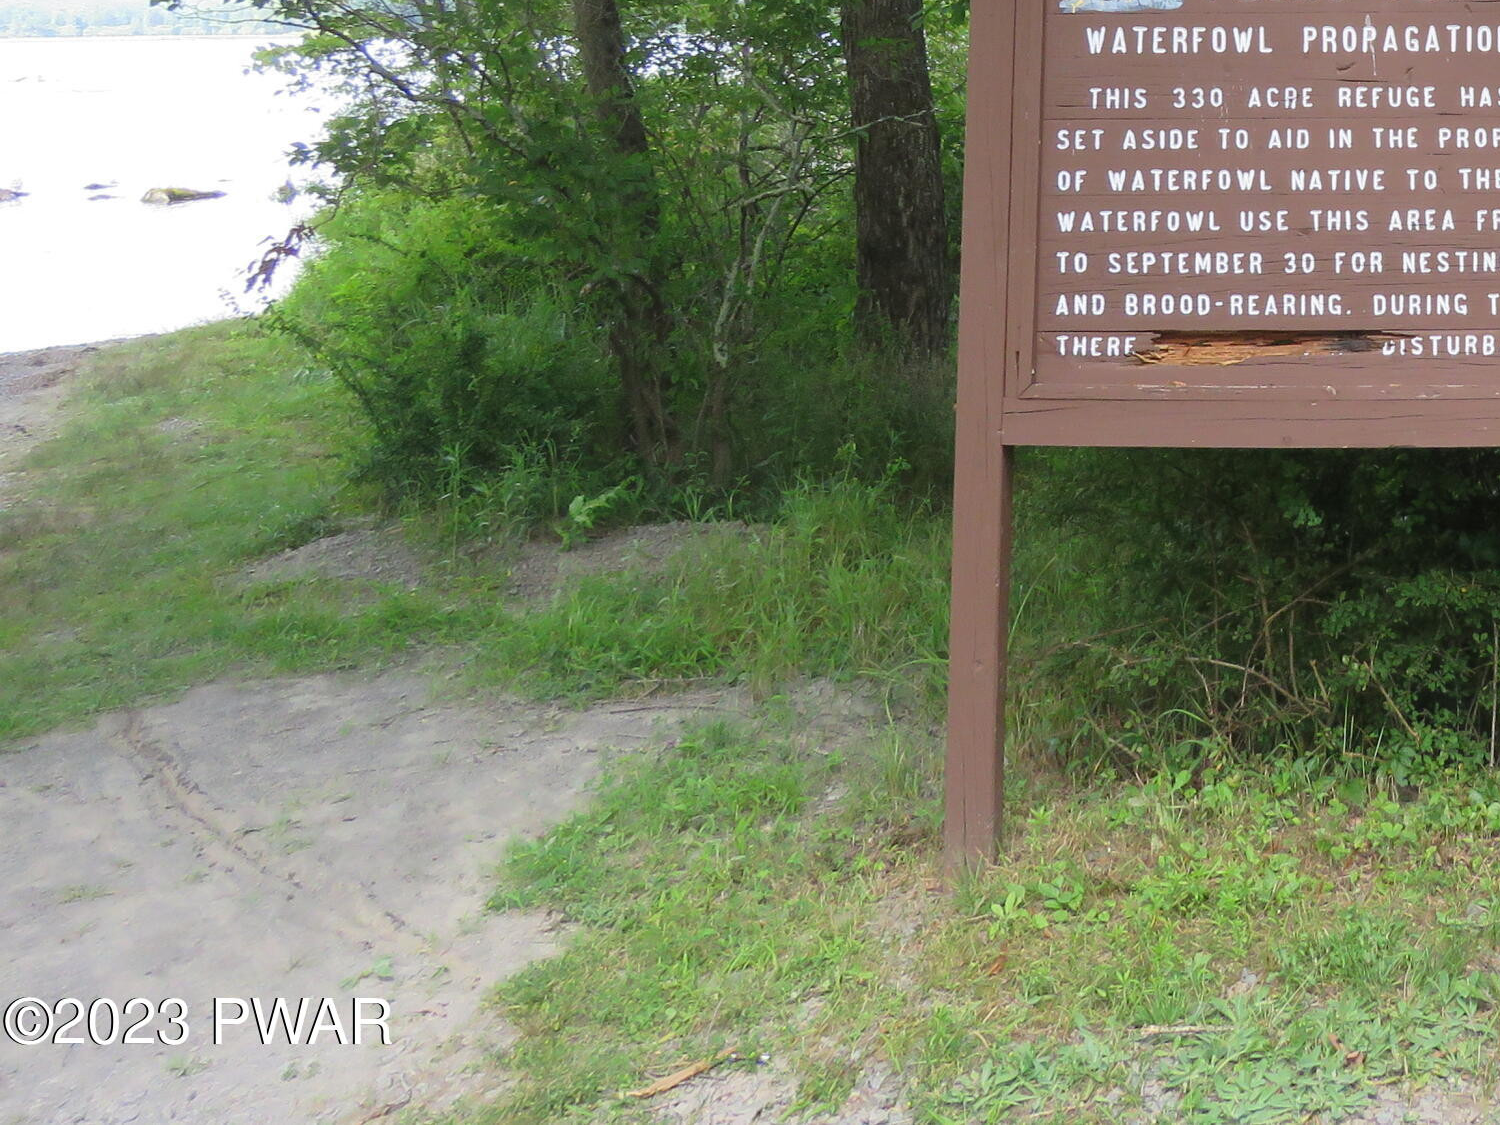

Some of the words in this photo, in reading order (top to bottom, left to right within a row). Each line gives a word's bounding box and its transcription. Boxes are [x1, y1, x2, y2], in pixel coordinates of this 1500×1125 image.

[1086, 25, 1273, 55] WATERFOWL
[1088, 87, 1147, 110] THIS
[1172, 87, 1223, 109] 330
[1247, 86, 1314, 110] ACRE
[1337, 85, 1436, 109] REFUGE
[1056, 128, 1105, 150] SET
[1122, 128, 1199, 151] ASIDE
[1217, 127, 1249, 150] TO
[1267, 127, 1310, 150] AID
[1328, 128, 1353, 149] IN
[1372, 126, 1419, 149] THE
[1057, 169, 1087, 192] OF
[1107, 168, 1273, 192] WATERFOWL
[1290, 168, 1386, 192] NATIVE
[1406, 168, 1438, 191] TO
[1056, 210, 1221, 233] WATERFOWL
[1239, 209, 1289, 232] USE
[1309, 209, 1369, 232] THIS
[1388, 208, 1456, 232] AREA
[1055, 251, 1088, 274] TO
[1108, 251, 1263, 275] SEPTEMBER
[1283, 251, 1316, 274] 30
[1334, 251, 1383, 274] FOR
[1055, 293, 1106, 316] AND
[1124, 293, 1352, 316] BROOD-REARING.
[1372, 293, 1468, 316] DURING
